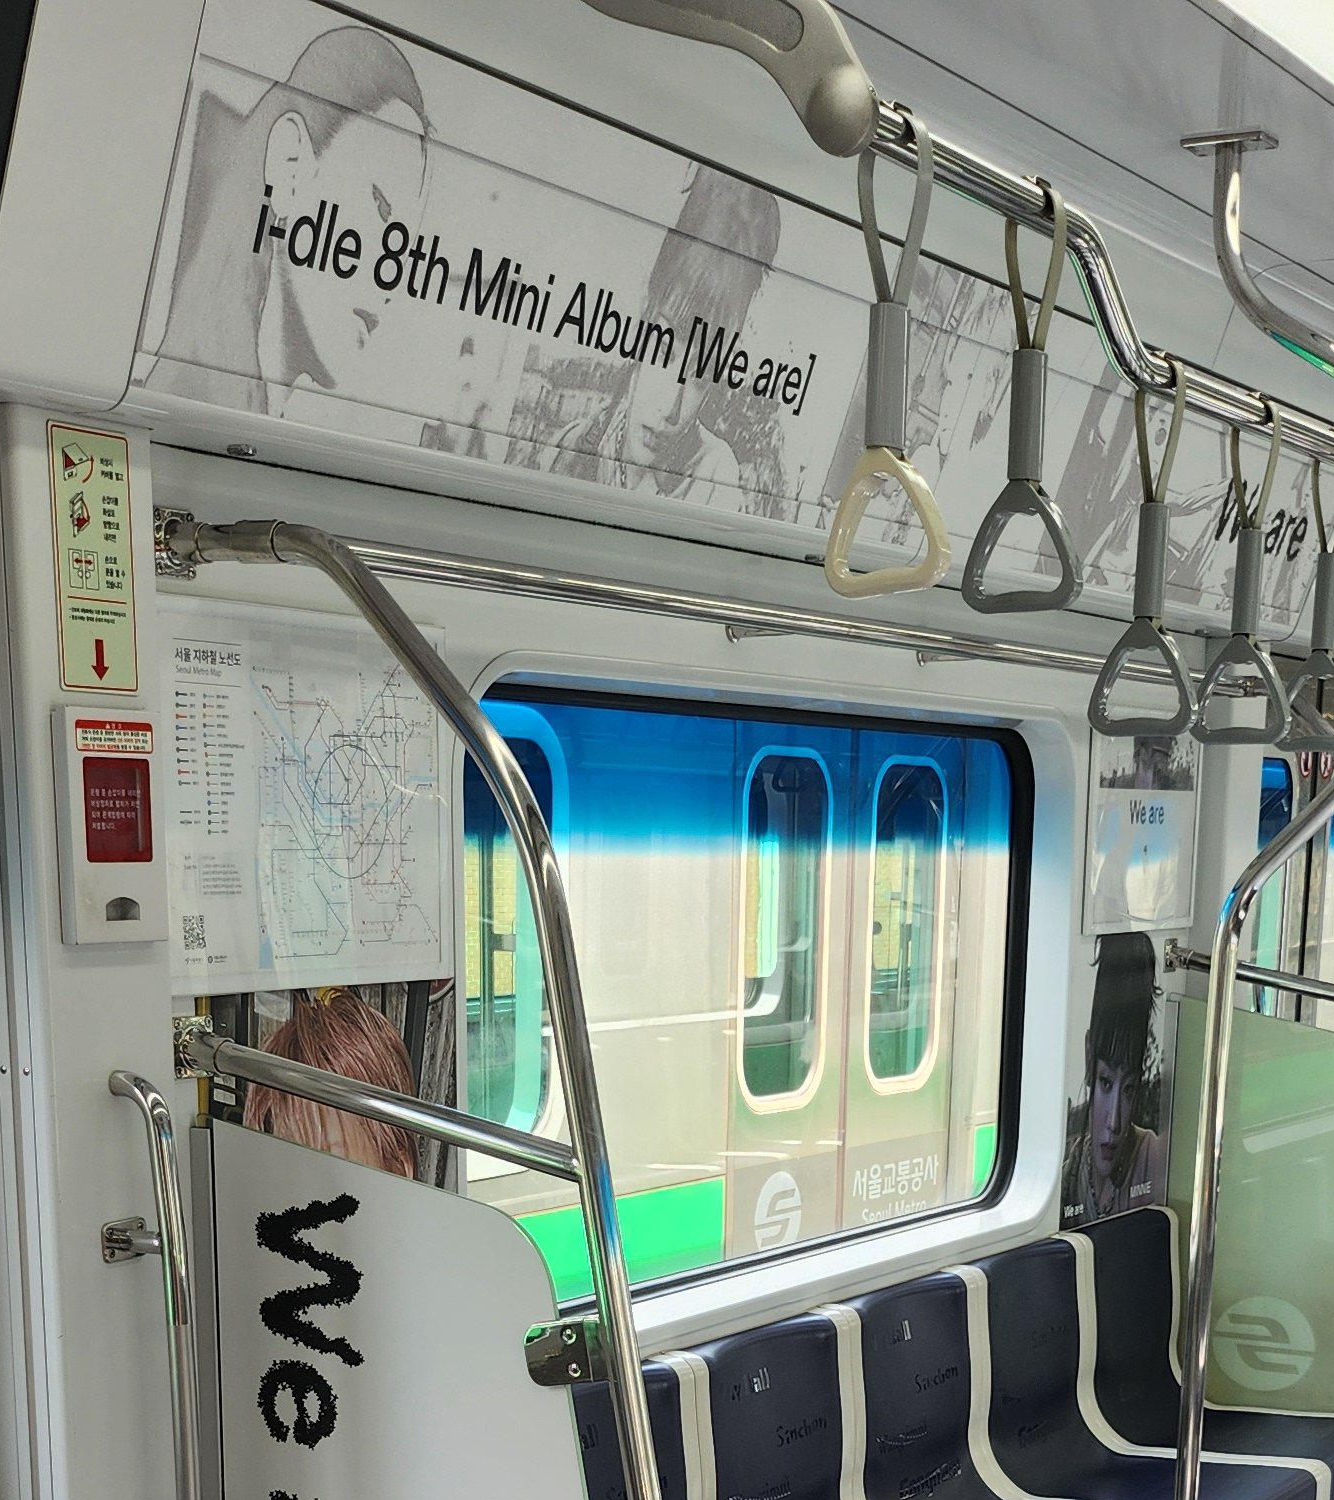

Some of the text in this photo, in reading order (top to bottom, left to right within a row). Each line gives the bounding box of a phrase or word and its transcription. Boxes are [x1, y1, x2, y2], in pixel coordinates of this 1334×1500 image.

[252, 185, 817, 417] i-dle 8th Mini Album [We are]
[175, 647, 241, 667] 서울 지하철 노선도
[1129, 799, 1165, 825] We are
[852, 1154, 940, 1201] 서울교통공사
[255, 1193, 364, 1450] We
